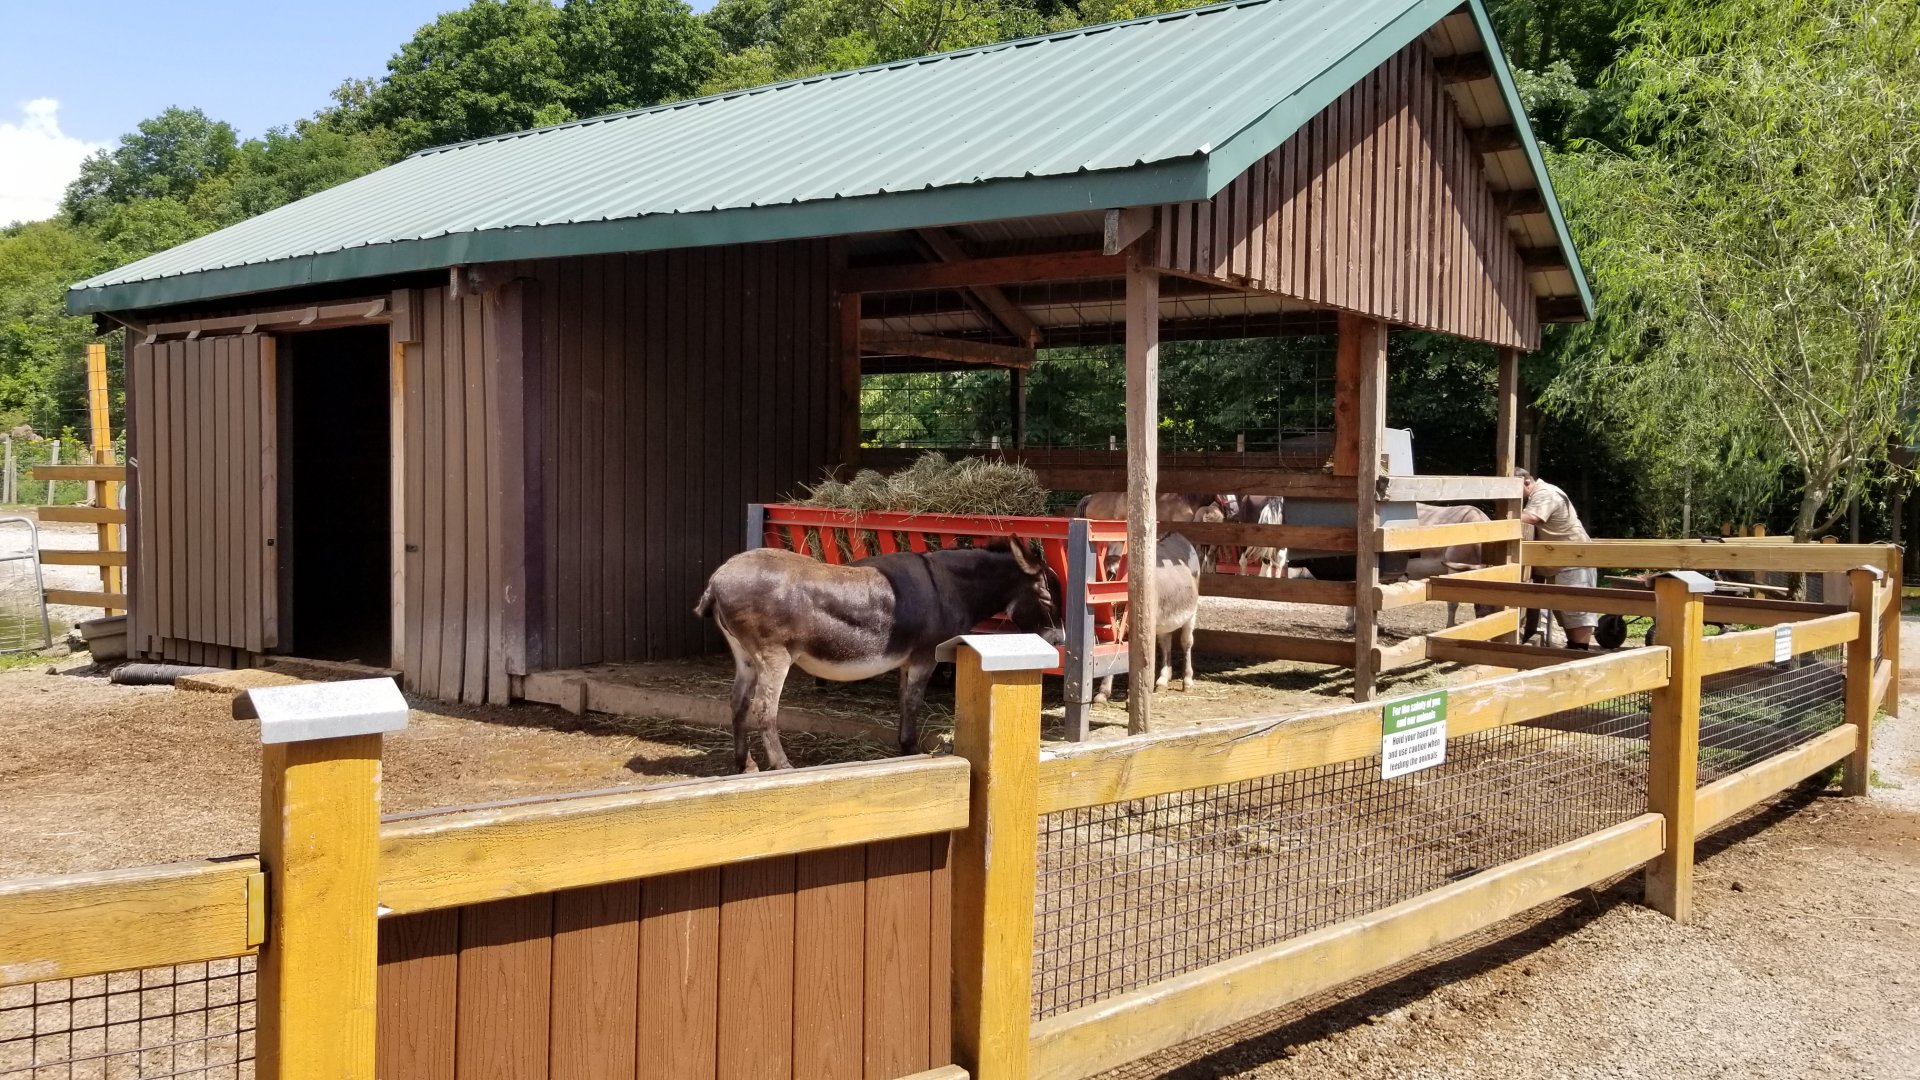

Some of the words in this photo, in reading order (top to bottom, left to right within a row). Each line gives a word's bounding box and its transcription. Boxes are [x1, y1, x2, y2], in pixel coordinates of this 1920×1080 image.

[1393, 734, 1404, 745] Hold
[1405, 733, 1416, 743] your
[1417, 729, 1429, 739] hand
[1388, 749, 1397, 759] and
[1399, 748, 1408, 756] use
[1409, 743, 1427, 753] caution
[1428, 738, 1440, 748] when
[1390, 759, 1409, 771] feeding
[1419, 751, 1437, 762] animals
